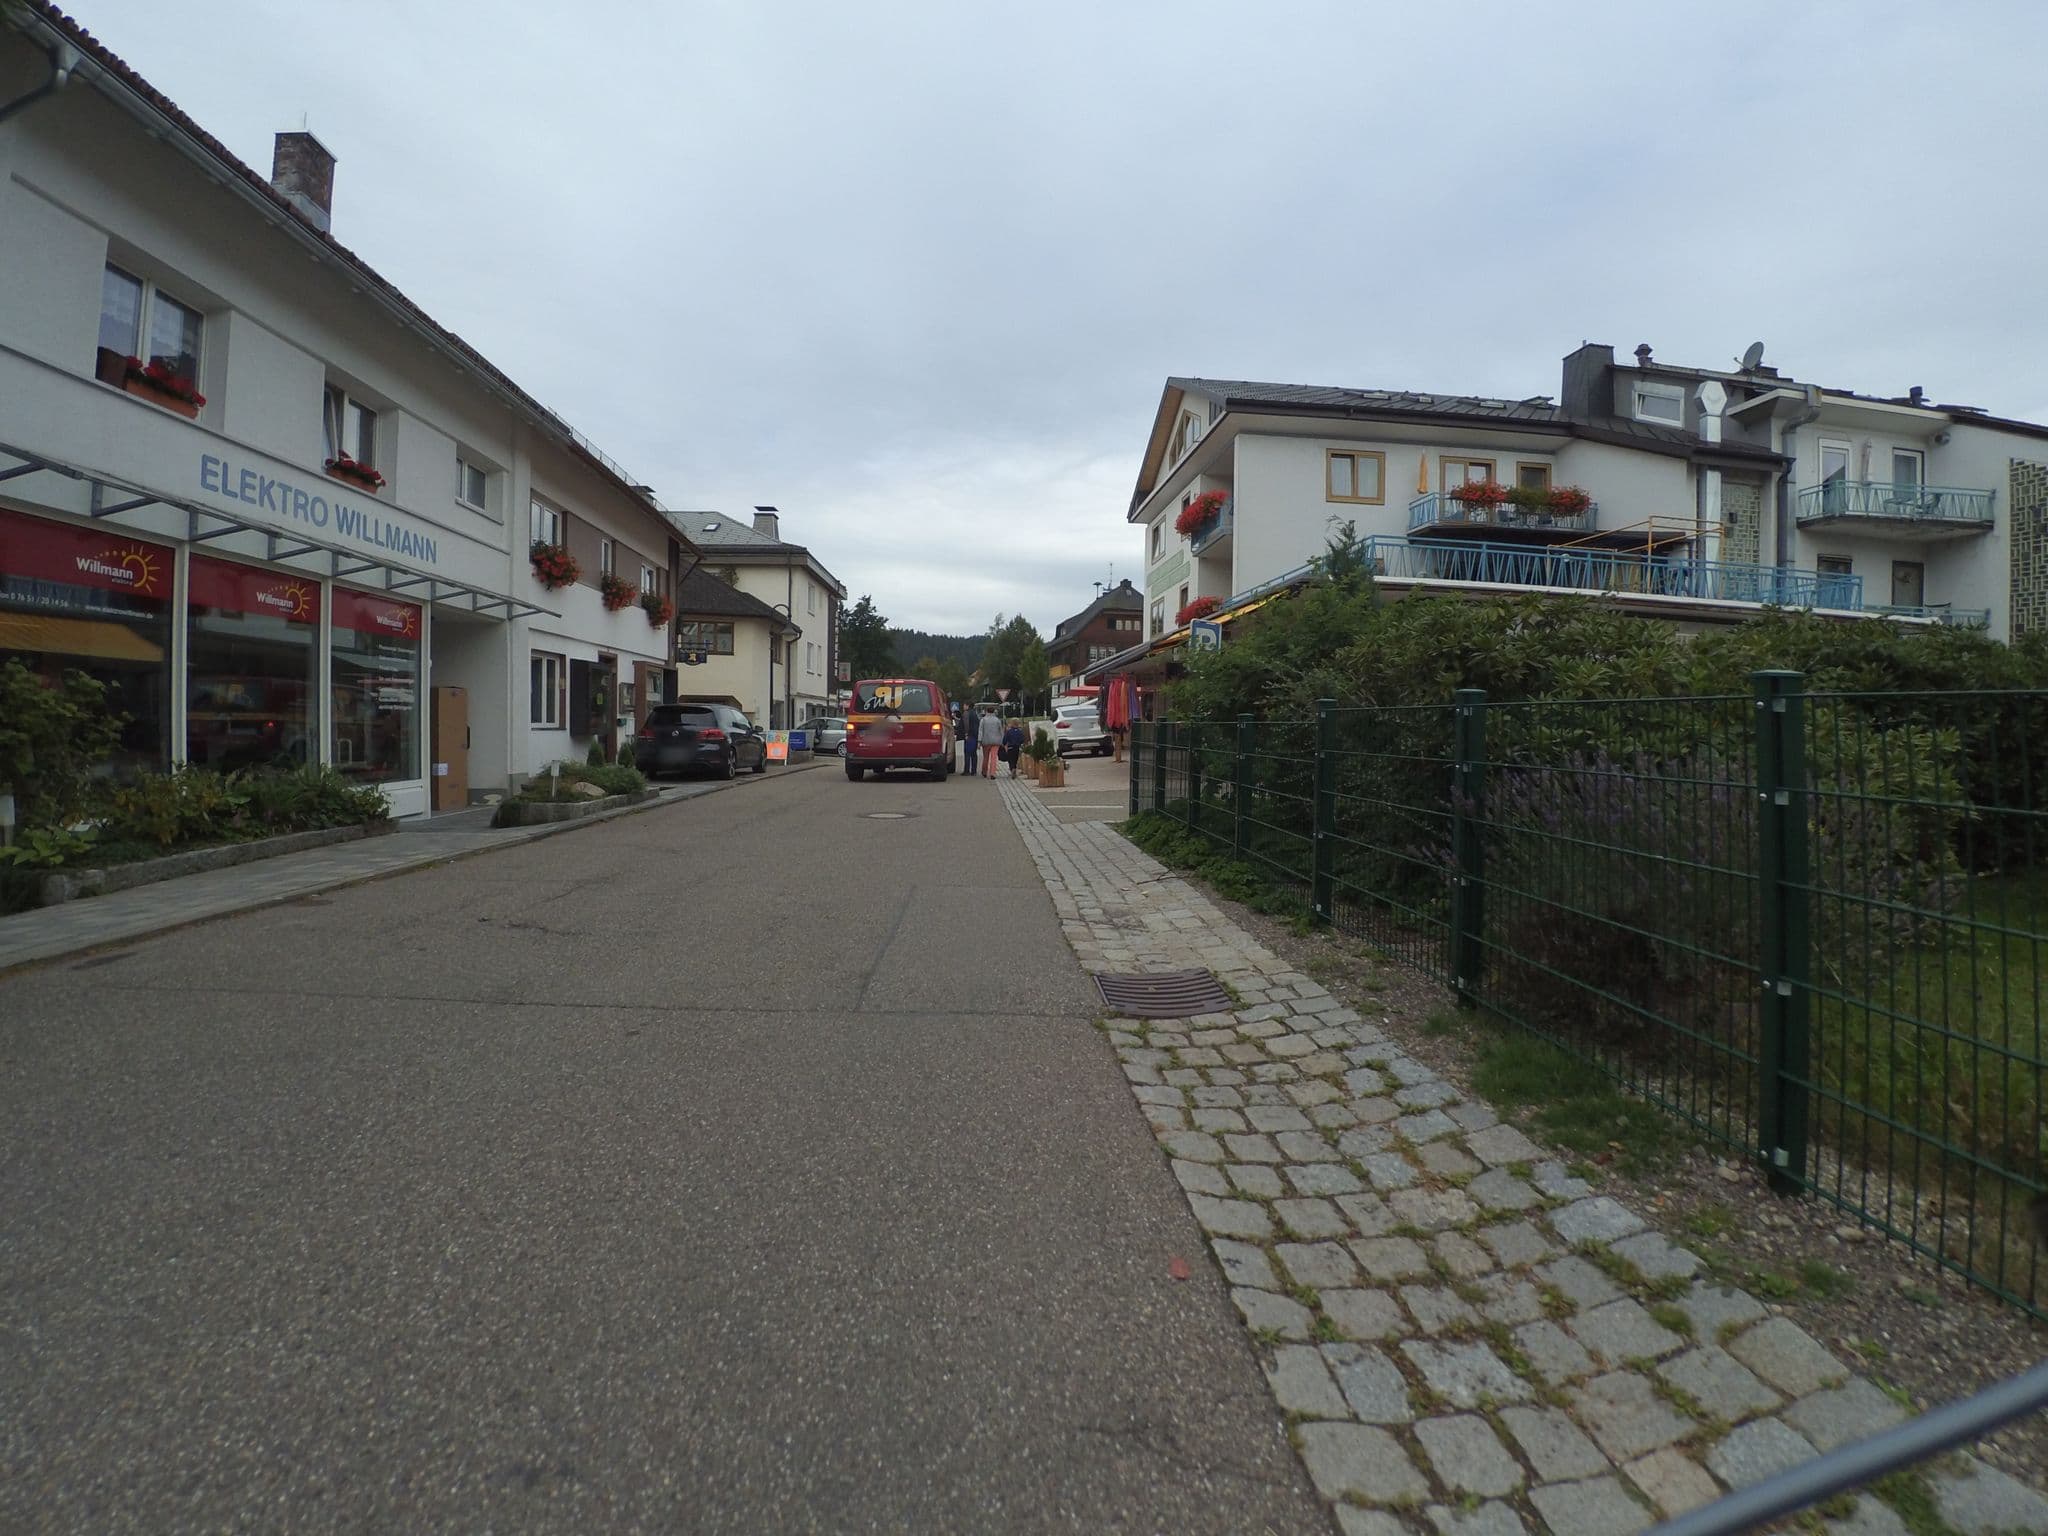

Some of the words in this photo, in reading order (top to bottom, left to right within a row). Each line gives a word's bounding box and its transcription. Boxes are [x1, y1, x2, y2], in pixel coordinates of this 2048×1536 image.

[200, 454, 329, 528] ELEKTRO
[335, 503, 437, 564] WILLMANN
[76, 556, 133, 579] Willmann
[256, 592, 293, 608] Willmann
[376, 615, 403, 629] Willmann
[1195, 627, 1217, 651] P
